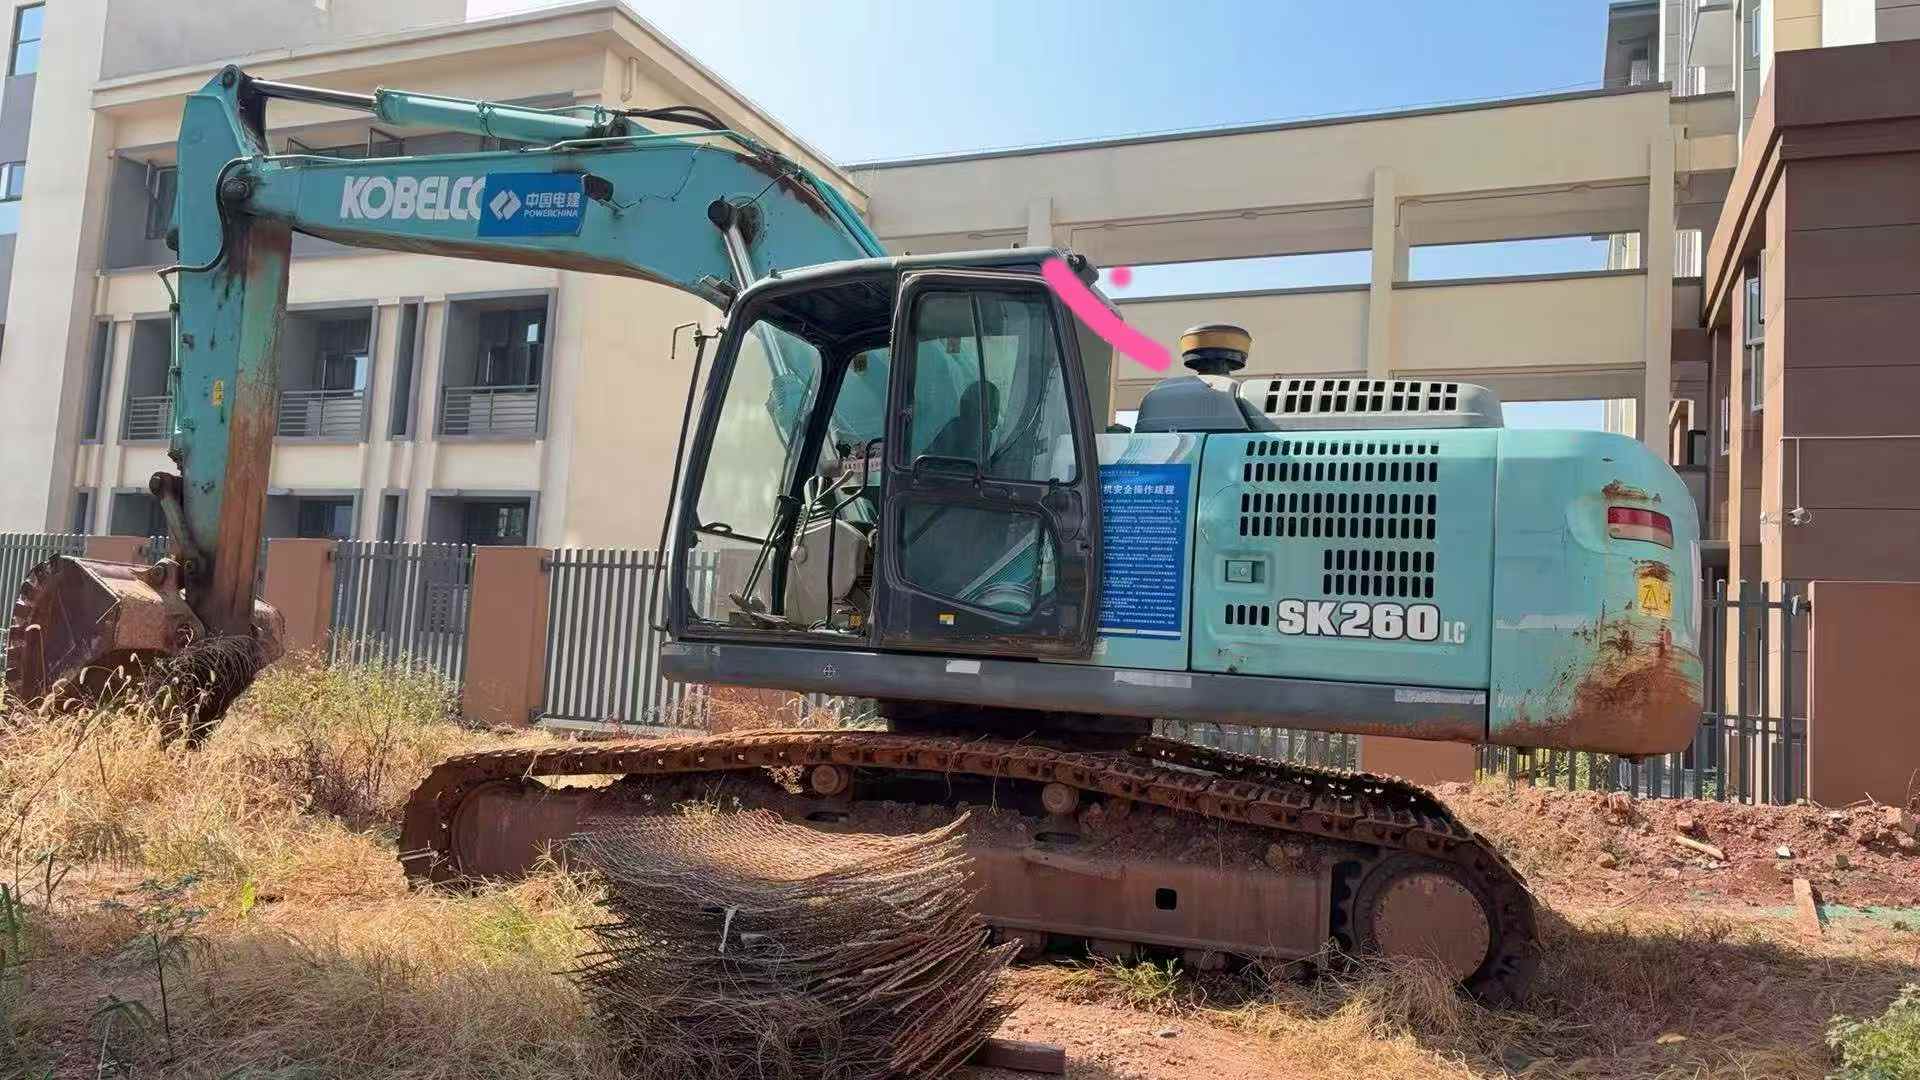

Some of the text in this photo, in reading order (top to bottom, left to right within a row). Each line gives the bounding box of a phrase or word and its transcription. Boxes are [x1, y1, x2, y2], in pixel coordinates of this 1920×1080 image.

[526, 192, 581, 208] 中国电建
[524, 209, 578, 217] POWERCHINA
[1277, 598, 1440, 642] SK260
